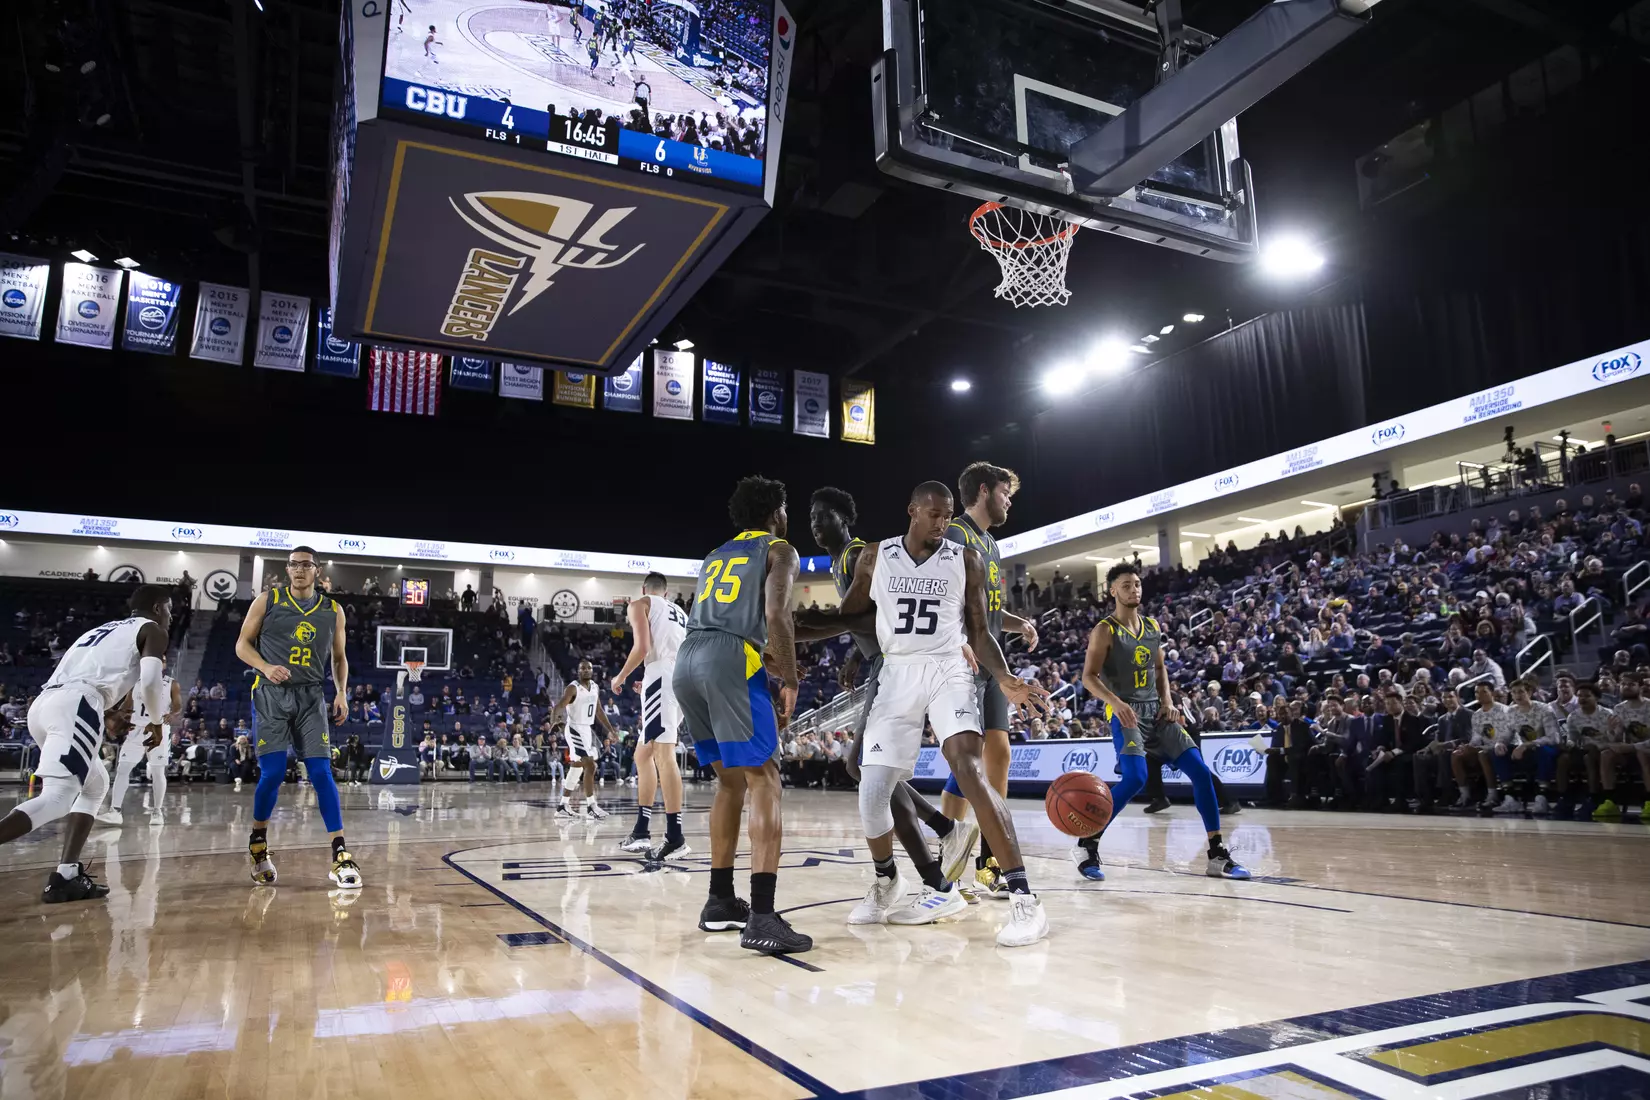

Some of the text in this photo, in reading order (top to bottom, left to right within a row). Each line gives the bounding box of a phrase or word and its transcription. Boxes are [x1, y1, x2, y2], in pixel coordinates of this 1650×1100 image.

[773, 48, 785, 123] pepsi
[406, 86, 467, 119] CBU
[502, 106, 514, 129] 4
[486, 129, 520, 143] FLS 1
[565, 120, 606, 146] 16:45
[559, 144, 610, 162] 1ST HALF
[655, 140, 666, 161] 6
[640, 162, 673, 177] FLS 0
[3, 272, 29, 280] MEN'S
[142, 290, 167, 299] MEN'S
[209, 290, 239, 301] 2015
[440, 248, 527, 341] LANCERS
[211, 301, 234, 309] MEN'S
[271, 300, 298, 309] 2014
[200, 306, 245, 318] BASKETBALL
[60, 325, 110, 337] TOURNAMENT
[68, 320, 99, 329] DIVISION
[198, 336, 232, 346] DIVISION
[316, 353, 357, 364] CHAMPIONS
[1602, 355, 1630, 373] FOX
[711, 362, 732, 371] 2017
[708, 370, 735, 378] WOMEN'S
[504, 381, 538, 389] CHAMPIONS
[604, 391, 640, 400] CHAMPIONS
[1469, 386, 1515, 408] AM1350
[1474, 398, 1508, 413] RIVERSIDE
[1478, 401, 1522, 418] BERNARDINO
[1378, 426, 1397, 439] FOX
[1220, 476, 1232, 486] FOX
[0, 515, 11, 523] OX
[80, 518, 117, 527] AM1350
[178, 528, 195, 536] FOX
[344, 539, 360, 547] FOX
[808, 558, 815, 572] 4
[697, 556, 749, 604] 35
[888, 576, 949, 596] LANCERS
[407, 590, 424, 605] 30
[667, 604, 686, 628] 33
[895, 597, 940, 635] 35
[77, 628, 118, 648] 31
[289, 646, 311, 667] 22
[1133, 669, 1148, 689] 13
[587, 703, 594, 718] 0
[392, 705, 405, 748] CBU
[918, 750, 937, 761] 1350
[1069, 753, 1090, 767] FOX
[1222, 749, 1252, 766] FOX
[1008, 769, 1040, 778] ERNARDINO
[1221, 765, 1252, 773] SPORTS
